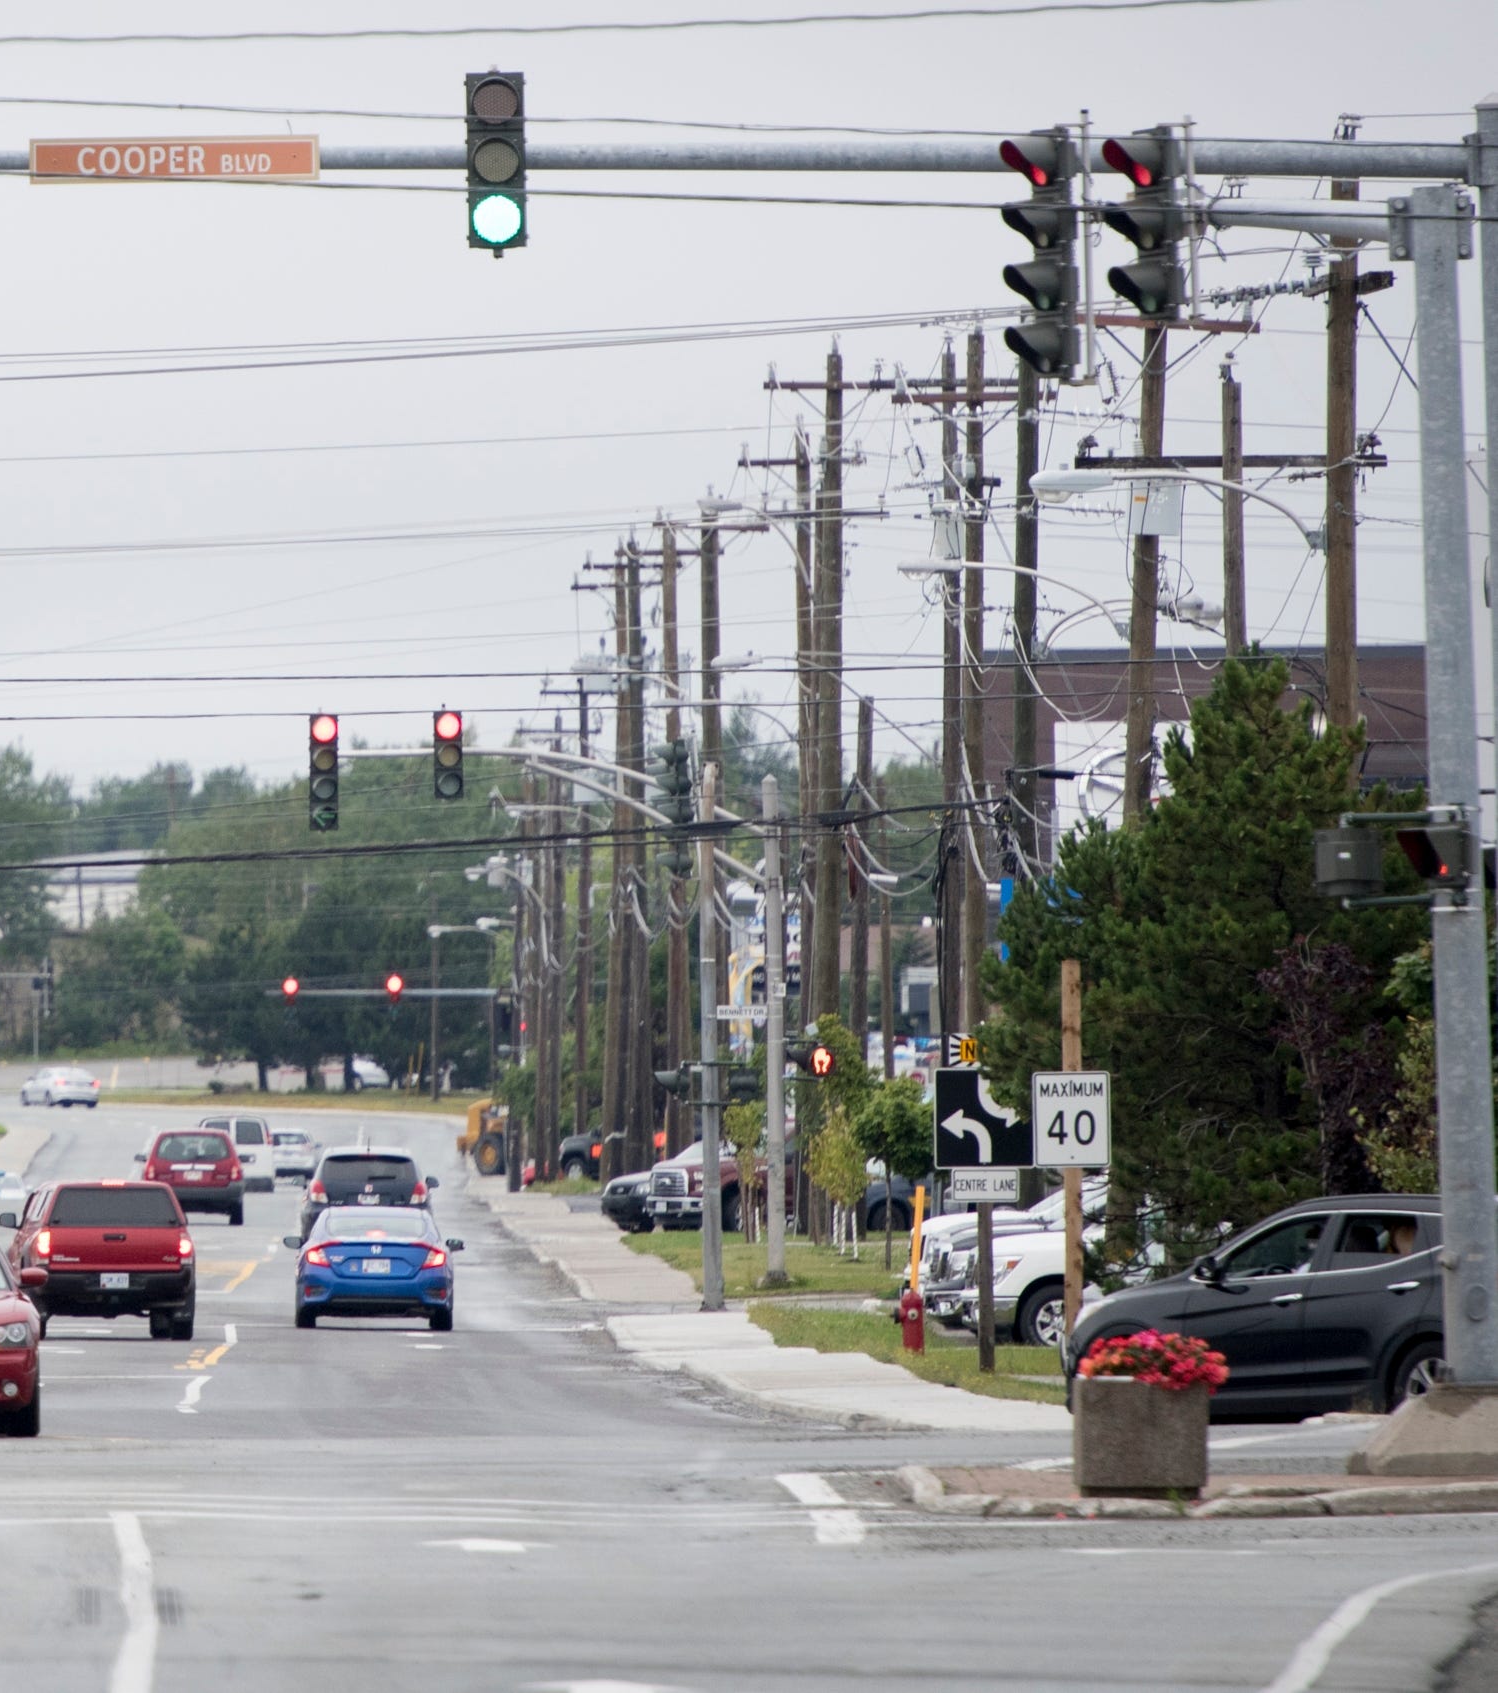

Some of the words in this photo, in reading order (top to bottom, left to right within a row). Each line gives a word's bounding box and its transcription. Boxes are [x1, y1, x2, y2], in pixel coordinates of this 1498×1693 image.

[78, 145, 205, 175] COOPER
[221, 153, 271, 173] BLVD
[1039, 1081, 1104, 1097] MAXIMUM
[1047, 1109, 1096, 1146] 40
[955, 1179, 990, 1192] CENTRE
[993, 1179, 1017, 1191] LANE
